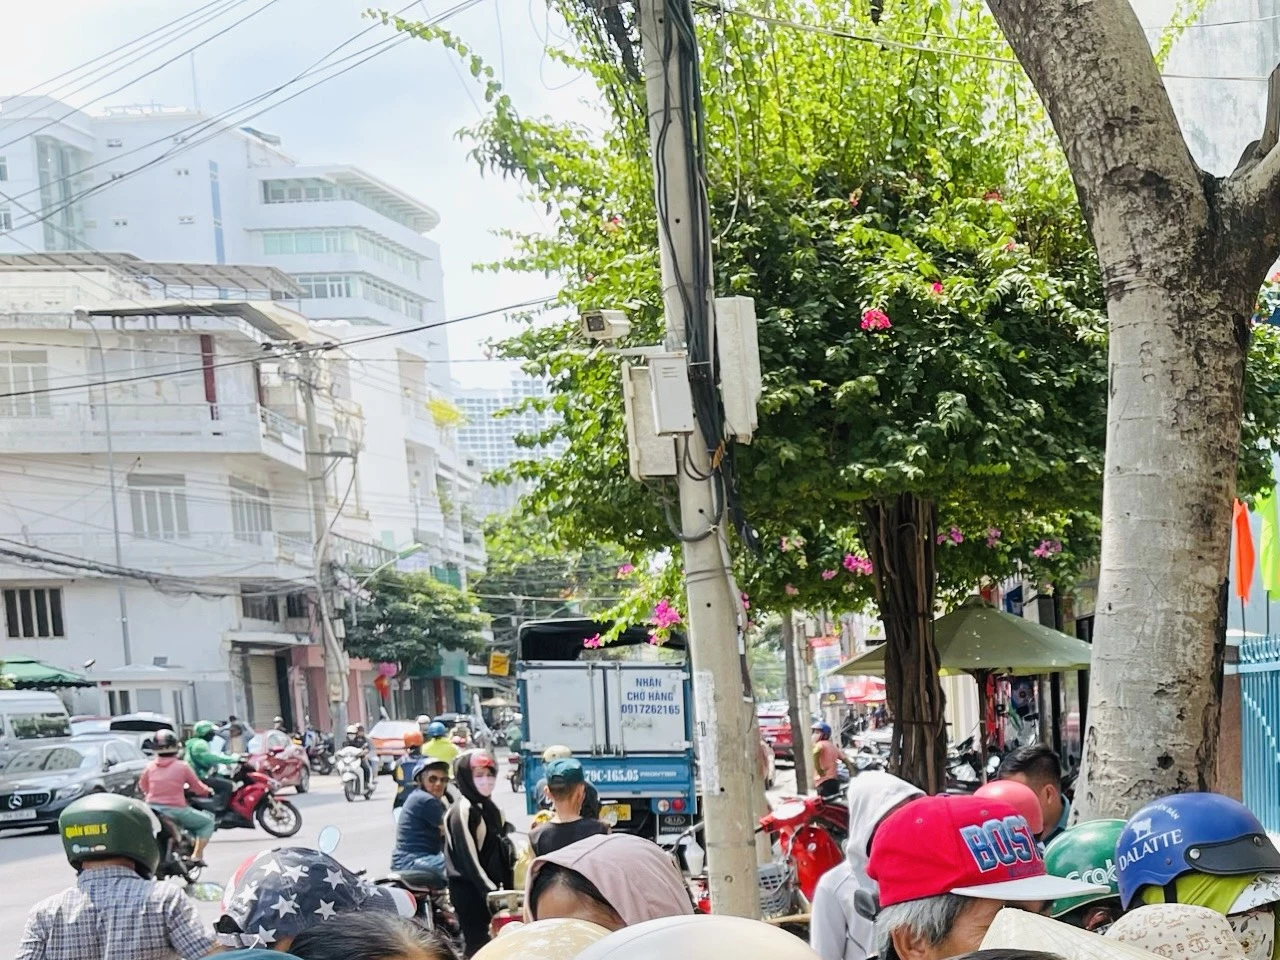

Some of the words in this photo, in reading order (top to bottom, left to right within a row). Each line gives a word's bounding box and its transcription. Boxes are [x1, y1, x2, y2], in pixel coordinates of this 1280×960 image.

[635, 677, 662, 689] NHẬN
[621, 704, 681, 715] 0917262165
[1119, 829, 1184, 871] DALATTE
